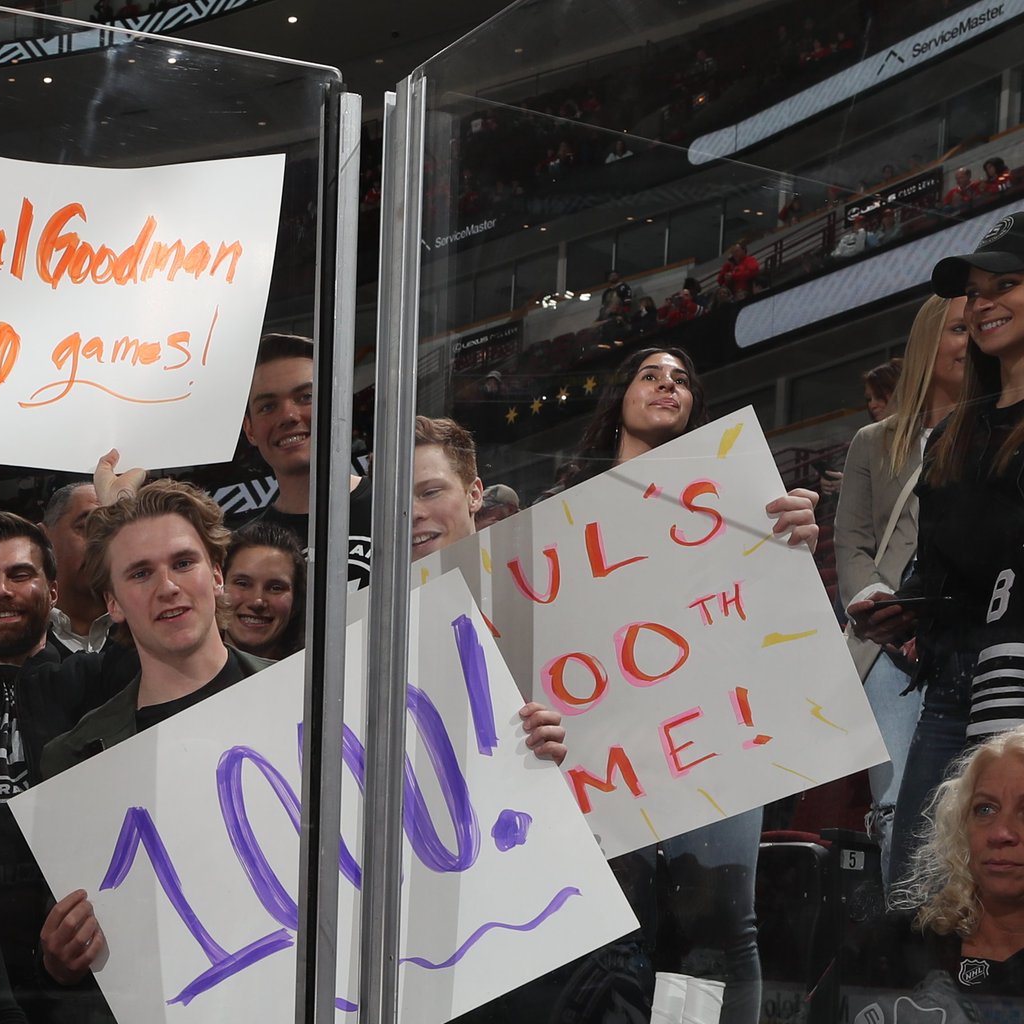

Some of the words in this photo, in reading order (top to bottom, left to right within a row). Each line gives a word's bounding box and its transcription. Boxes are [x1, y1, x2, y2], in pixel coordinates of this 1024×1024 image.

[912, 3, 1005, 58] ServiceMaster
[36, 202, 245, 290] Goodman
[435, 218, 497, 248] ServiceMaster
[19, 304, 220, 408] games!
[492, 477, 726, 618] UL'S
[848, 851, 857, 869] 5
[964, 966, 984, 981] NHL
